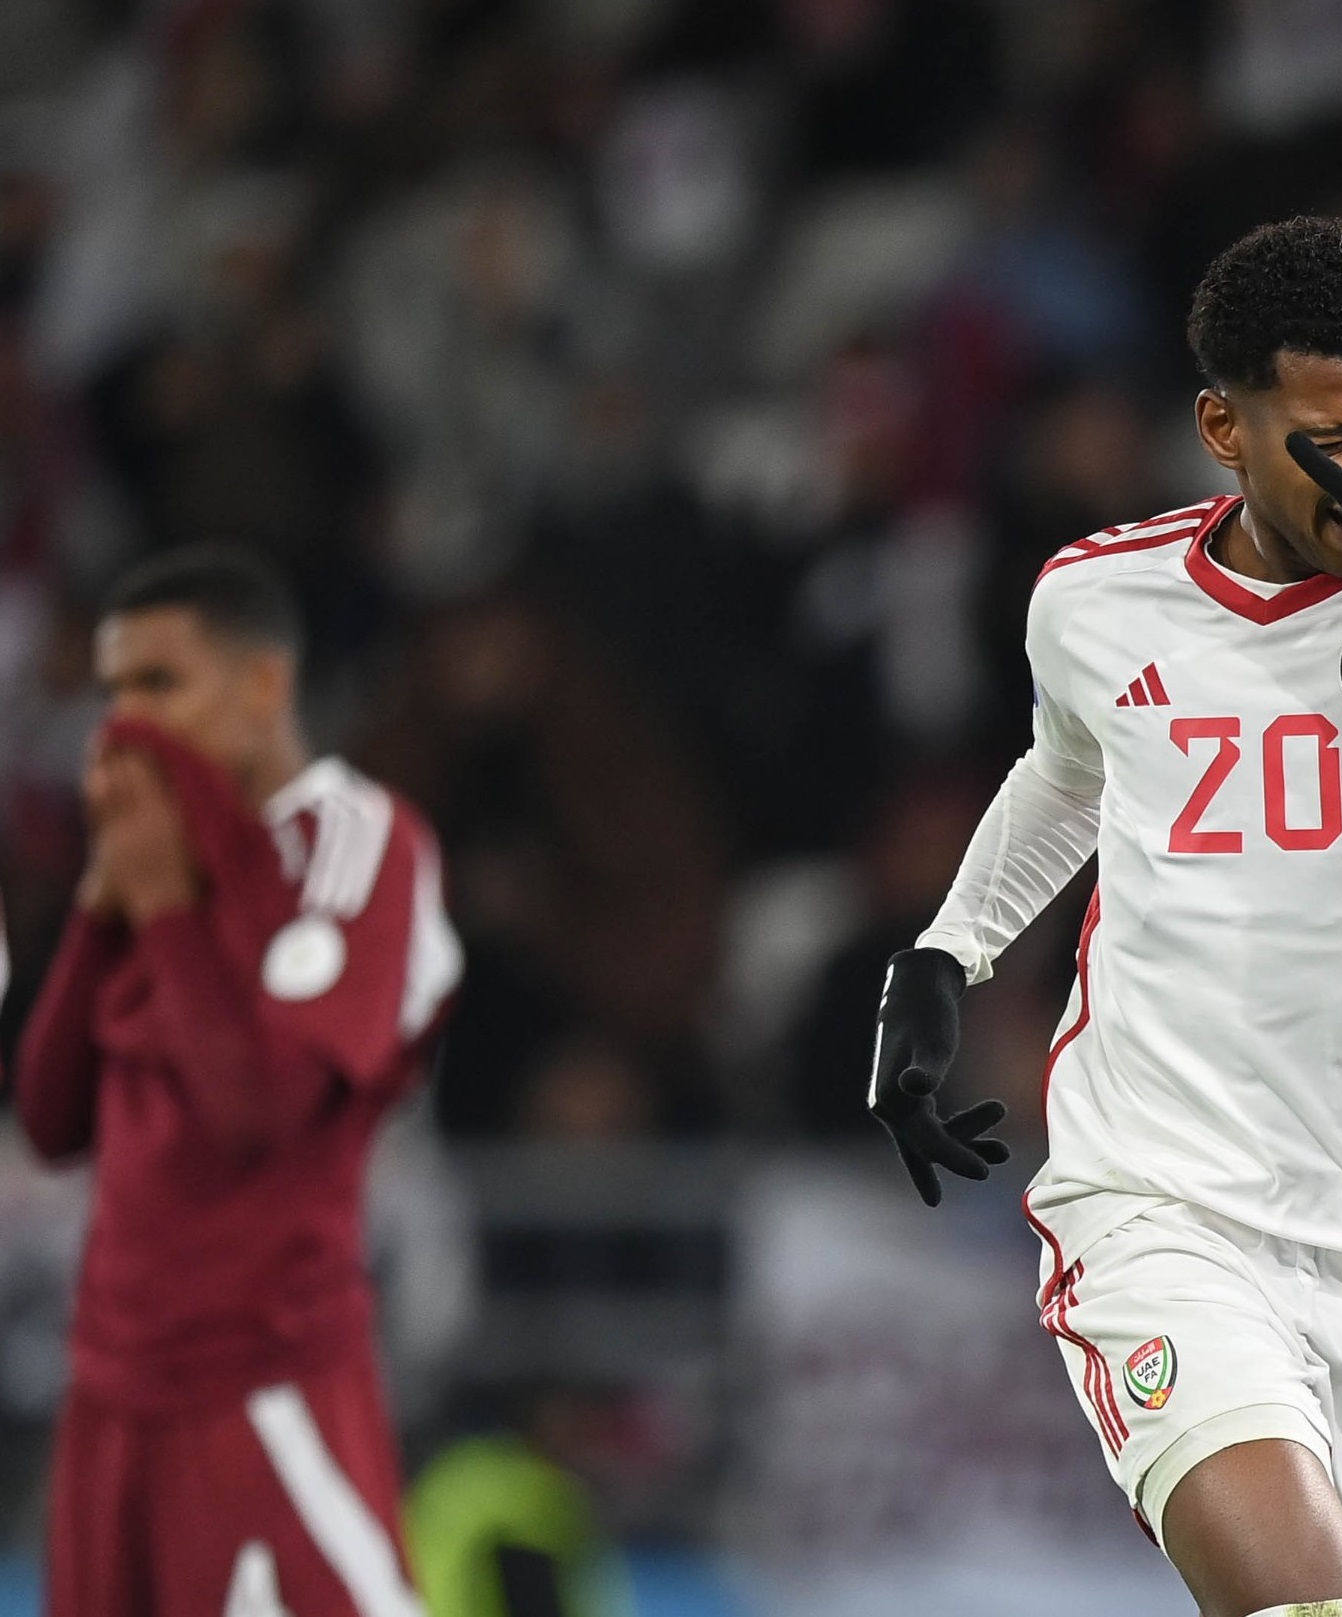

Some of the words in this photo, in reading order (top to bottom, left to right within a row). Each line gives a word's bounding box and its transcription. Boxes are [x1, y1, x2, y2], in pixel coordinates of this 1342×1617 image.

[1168, 714, 1342, 853] 20
[1136, 1356, 1161, 1377] UAE
[1144, 1369, 1159, 1383] FA
